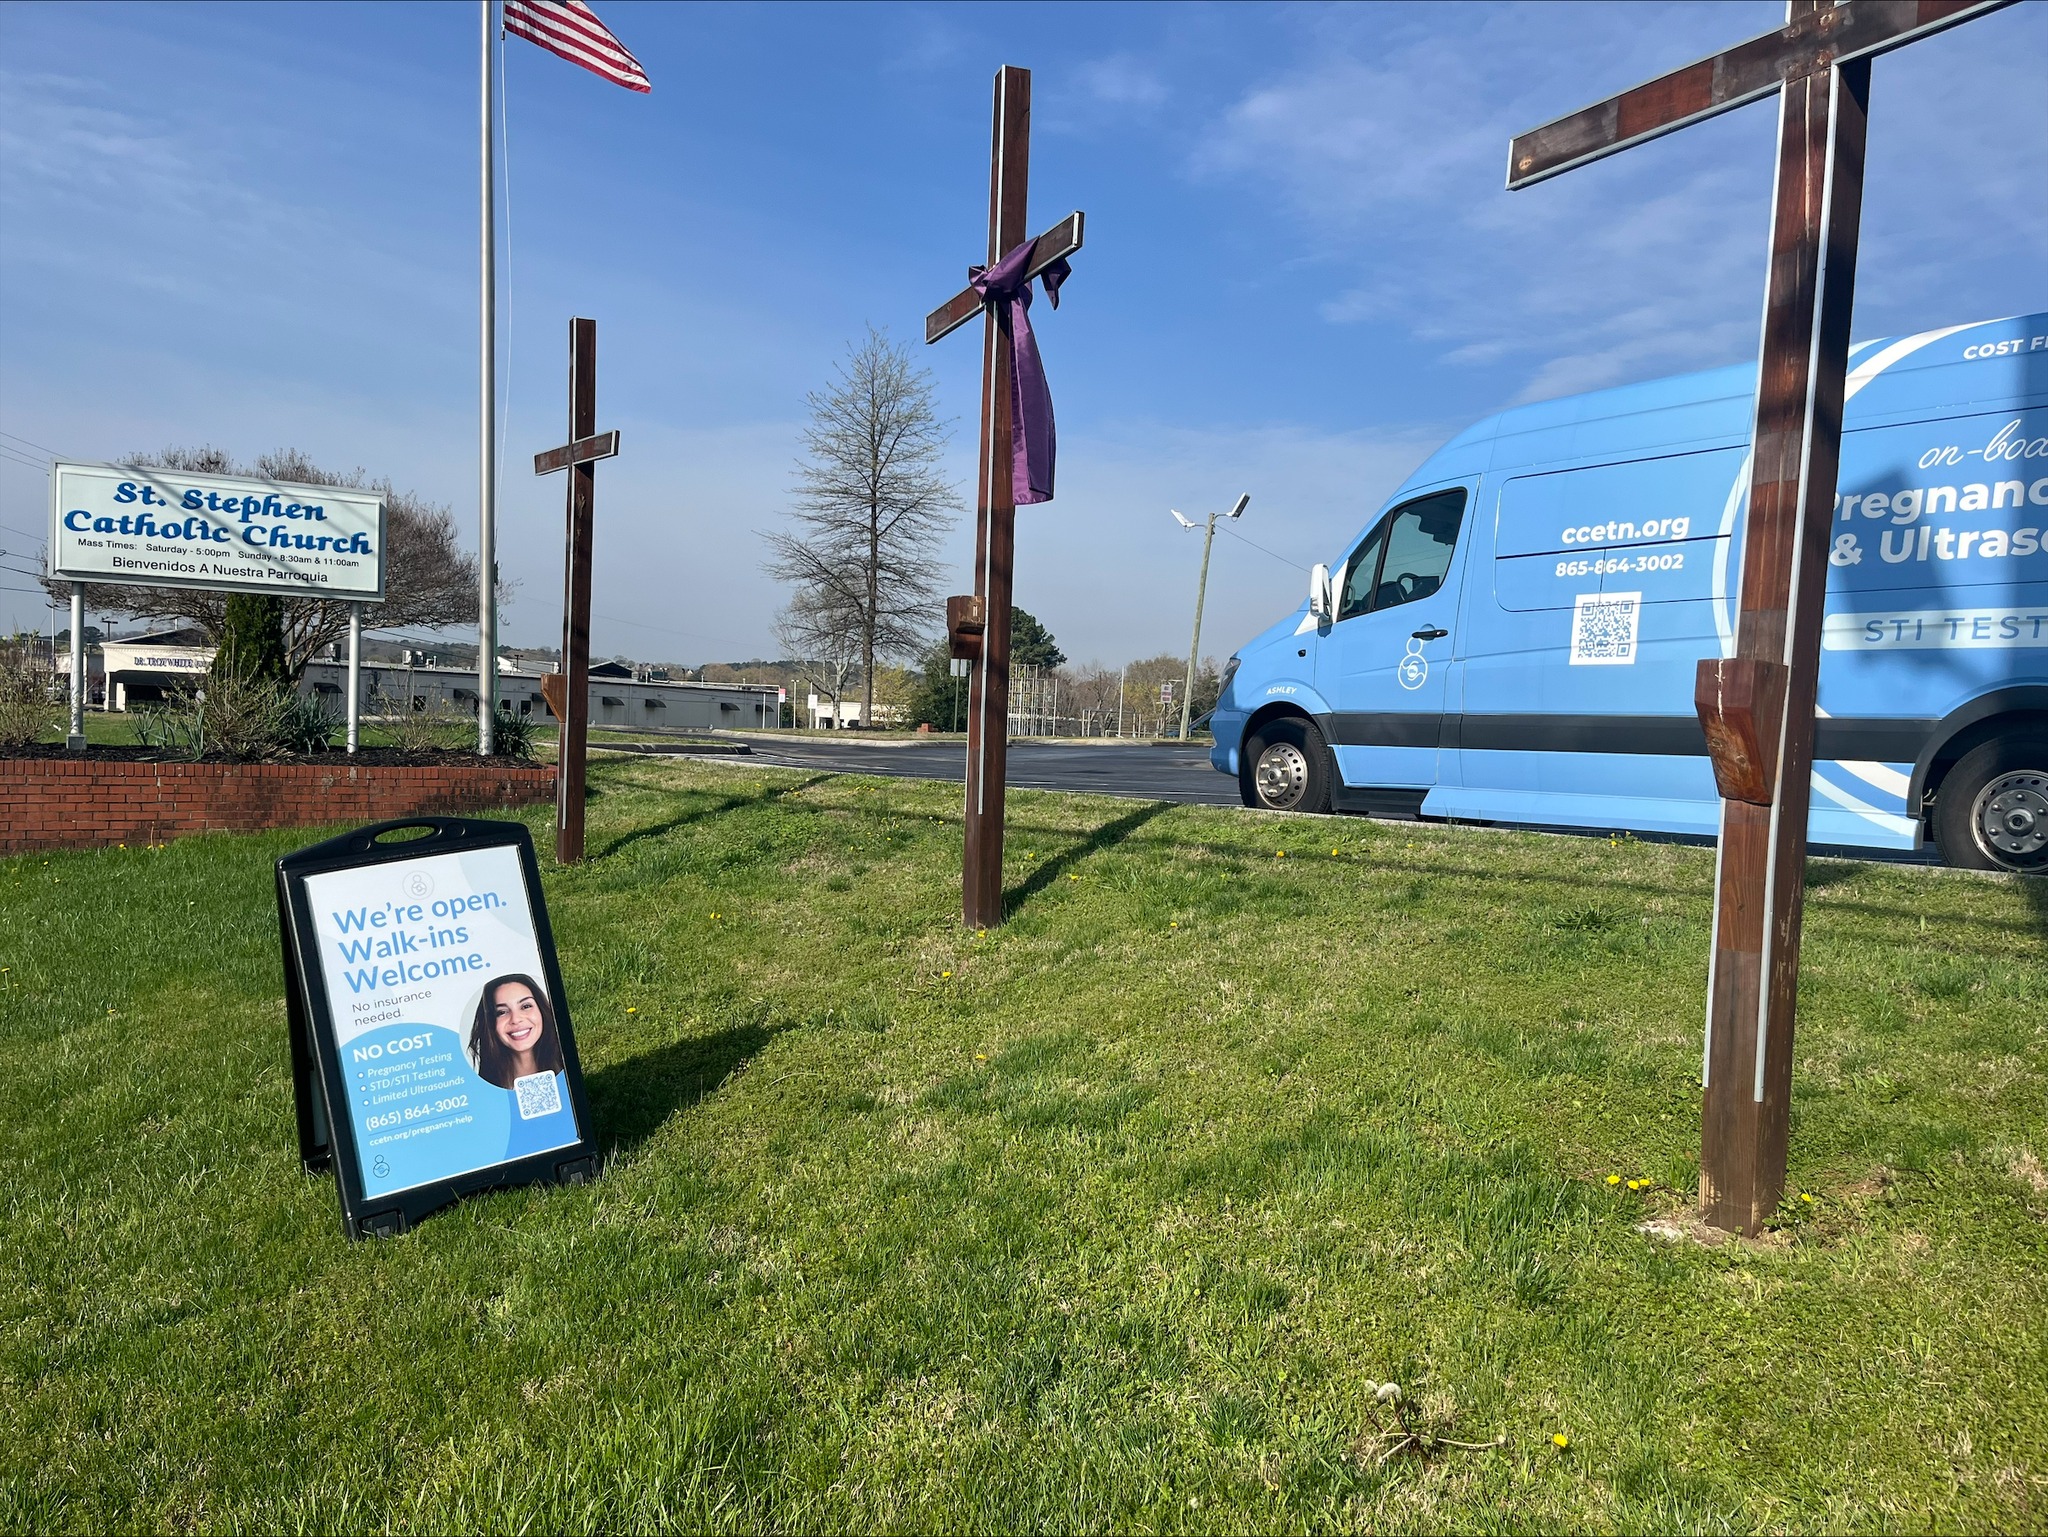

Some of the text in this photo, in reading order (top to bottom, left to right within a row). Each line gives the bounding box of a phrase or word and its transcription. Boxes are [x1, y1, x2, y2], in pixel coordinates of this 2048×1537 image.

[1963, 335, 2048, 360] COST F
[113, 482, 328, 523] St. Stephen
[1833, 477, 2048, 525] regnanc
[64, 509, 373, 555] Catholic Church
[1561, 517, 1690, 544] ccetn.org
[78, 538, 104, 548] Mass
[106, 541, 138, 551] Times:
[146, 543, 188, 556] Saturday
[195, 547, 231, 559] 5:00pm
[238, 550, 273, 563] Sunday
[279, 554, 312, 565] 8:30am
[314, 556, 322, 565] &
[324, 557, 360, 568] 11:00am
[1829, 526, 2048, 567] & Ultras
[112, 556, 328, 583] Bienvenidos A Nuestra Parroquia
[1555, 554, 1684, 577] 865-864-3002
[1864, 615, 2048, 643] STI TEST
[168, 658, 193, 668] WHITE
[1266, 686, 1297, 695] ASHLEY
[332, 890, 508, 935] We're open.
[337, 925, 470, 965] Walk-ins
[343, 952, 492, 994] Welcome.
[351, 988, 432, 1013] No insurance
[354, 1006, 405, 1027] needed.
[353, 1032, 434, 1063] NO COST
[367, 1052, 453, 1079] Pregnancy Testing
[370, 1066, 446, 1092] STD/STI Testing
[372, 1076, 465, 1106] Limited Ultrasounds
[365, 1095, 469, 1132] (865) 864-3002
[369, 1114, 473, 1146] ccetn.org/pregnancy-help
